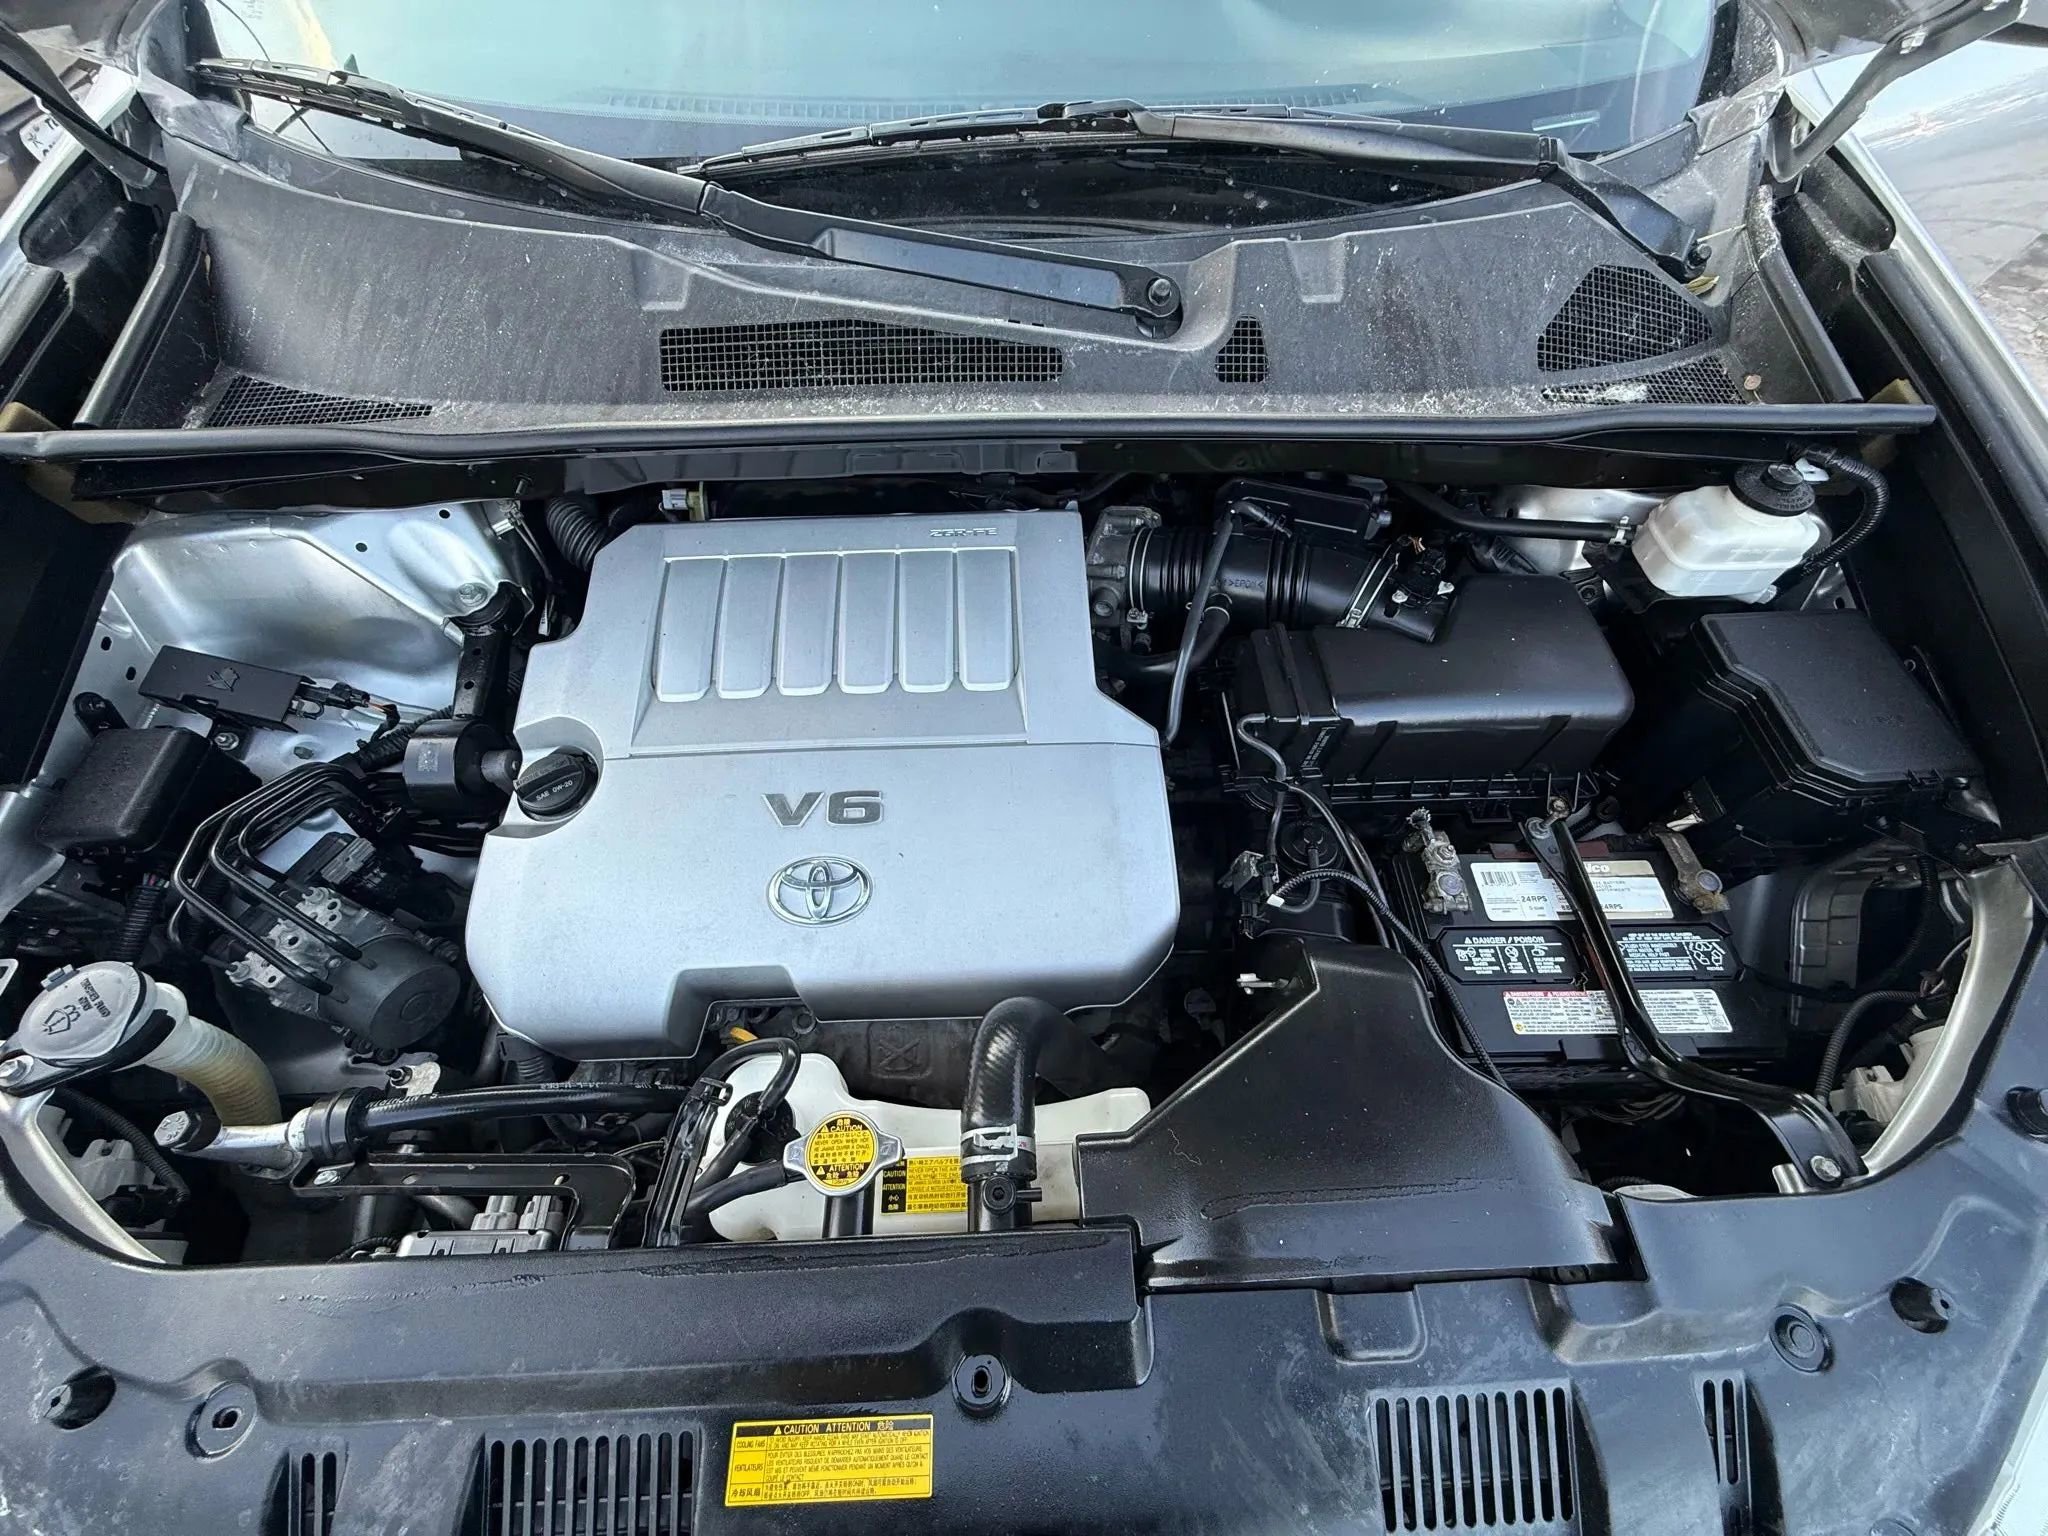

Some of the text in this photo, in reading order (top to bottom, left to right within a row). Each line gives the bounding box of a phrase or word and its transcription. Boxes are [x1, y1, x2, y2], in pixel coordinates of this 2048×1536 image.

[536, 780, 572, 800] SAE 0W-20
[761, 790, 883, 827] V6
[1514, 936, 1545, 944] POISON
[829, 1163, 864, 1171] ATTENTION
[784, 1424, 819, 1434] CAUTION
[826, 1422, 870, 1432] ATTENTION
